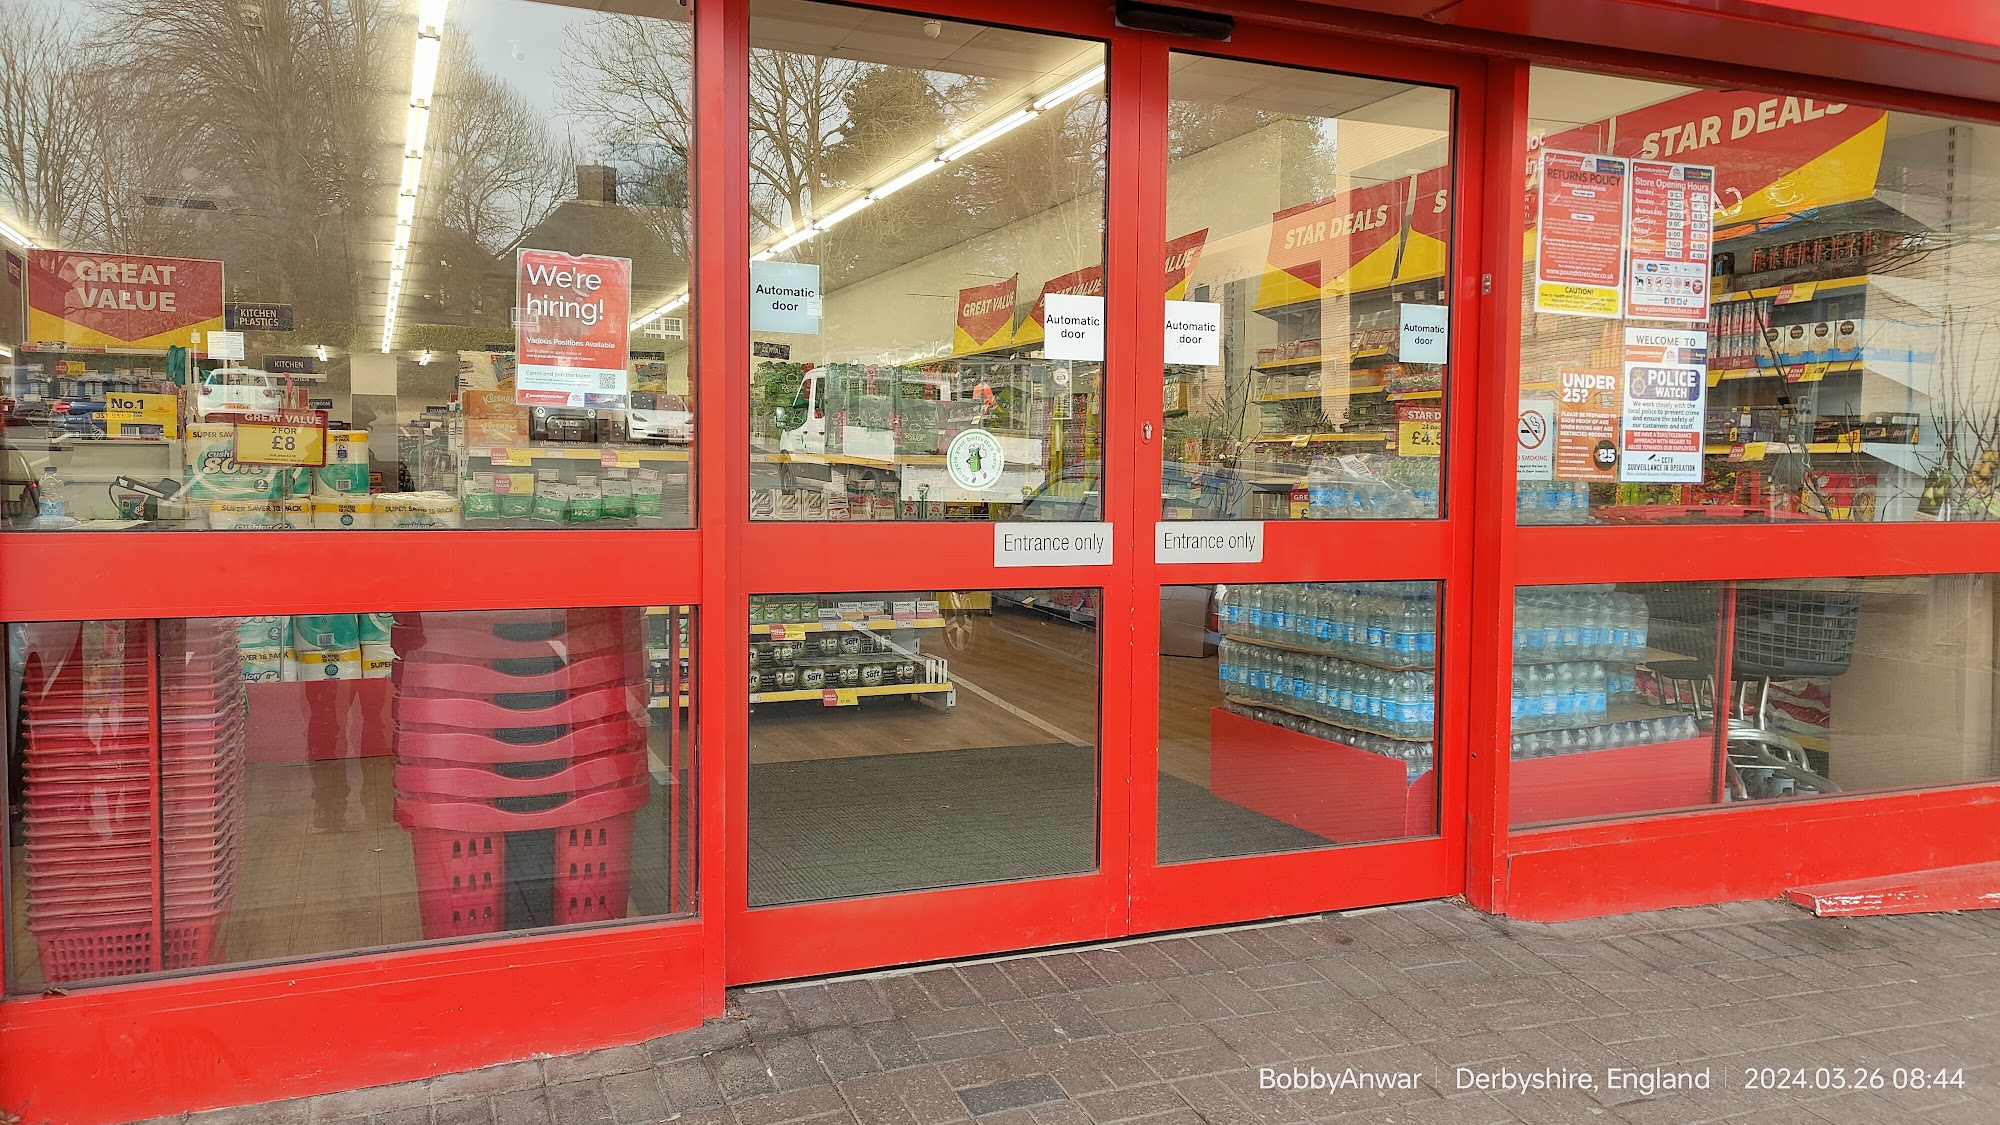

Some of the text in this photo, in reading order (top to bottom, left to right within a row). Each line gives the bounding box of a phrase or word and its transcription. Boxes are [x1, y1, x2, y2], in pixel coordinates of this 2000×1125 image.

[1643, 115, 1721, 159] STAR
[1547, 169, 1621, 186] RETURNS POLICY
[1635, 177, 1709, 192] Store Opening Hours
[1635, 188, 1655, 196] Monday
[1635, 198, 1655, 206] Tuesday
[1283, 204, 1389, 250] STAR DEALS
[1165, 248, 1197, 274] ALUE
[75, 261, 176, 286] GREAT
[526, 262, 602, 291] We're
[755, 284, 814, 298] Automatic
[1564, 287, 1594, 295] CAUTION!
[77, 288, 177, 313] VALUE
[772, 300, 799, 312] door
[962, 290, 1015, 317] GREAT VALUE
[240, 309, 277, 318] KITCHEN
[526, 293, 604, 326] hiring!
[239, 318, 279, 326] PLASTICS
[1046, 314, 1100, 327] Automatic
[1165, 320, 1216, 333] Automatic
[1060, 329, 1086, 340] door
[1403, 323, 1445, 335] Automatic
[526, 337, 616, 349] Various Positions Available
[1179, 334, 1202, 345] door
[1414, 336, 1434, 346] door
[1636, 335, 1696, 347] WELCOME TO
[274, 360, 304, 368] KITCHEN
[1562, 372, 1616, 390] UNDER
[1648, 369, 1697, 388] POLICE
[1562, 388, 1589, 404] 25?
[1655, 386, 1687, 398] WATCH
[111, 398, 144, 409] No.1
[1656, 401, 1673, 410] closely
[1408, 411, 1433, 420] STAR
[1641, 408, 1657, 416] police
[244, 412, 322, 425] GREAT VALUE
[278, 427, 297, 435] FOR
[481, 422, 518, 434] Kleenex
[271, 435, 296, 451] £8
[1411, 431, 1441, 446] £4.5
[954, 440, 966, 455] your
[207, 450, 233, 458] cushi
[1598, 448, 1616, 463] 25
[257, 479, 265, 489] 2
[1003, 533, 1104, 554] Entrance only
[1164, 532, 1256, 552] Entrance only
[271, 628, 279, 637] 2
[844, 636, 859, 647] Soft
[806, 672, 822, 682] Soft
[865, 669, 880, 680] Soft
